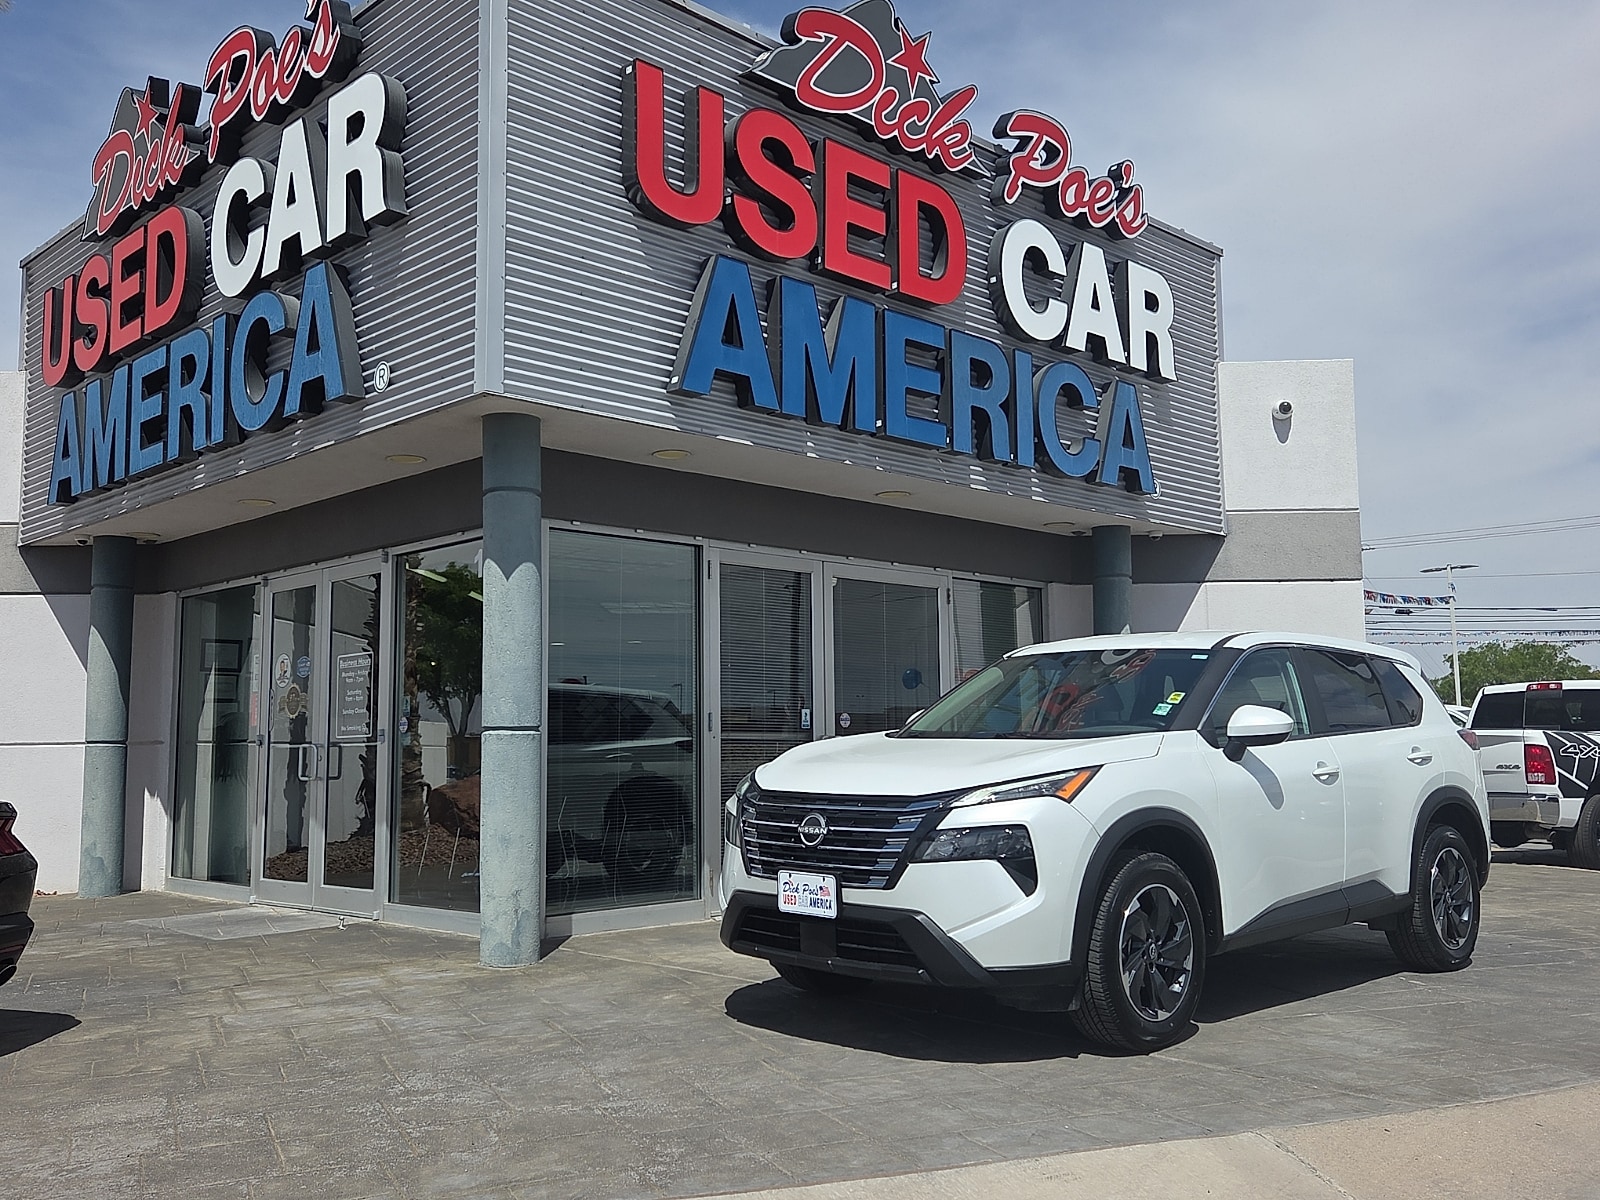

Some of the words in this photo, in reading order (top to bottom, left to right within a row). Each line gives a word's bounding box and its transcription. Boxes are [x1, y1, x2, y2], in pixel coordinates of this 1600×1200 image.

[42, 206, 189, 387] USED
[211, 72, 388, 298] CAR
[92, 83, 191, 236] Dick
[636, 58, 968, 305] USED
[1000, 218, 1178, 382] CAR
[795, 8, 978, 172] Dick
[1006, 112, 1148, 239] Poe's
[48, 261, 347, 506] AMERICA
[680, 254, 1157, 495] AMERICA
[782, 881, 800, 895] Dick
[783, 893, 797, 906] USED
[809, 896, 833, 911] AMERICA
[798, 826, 829, 835] NISSAN
